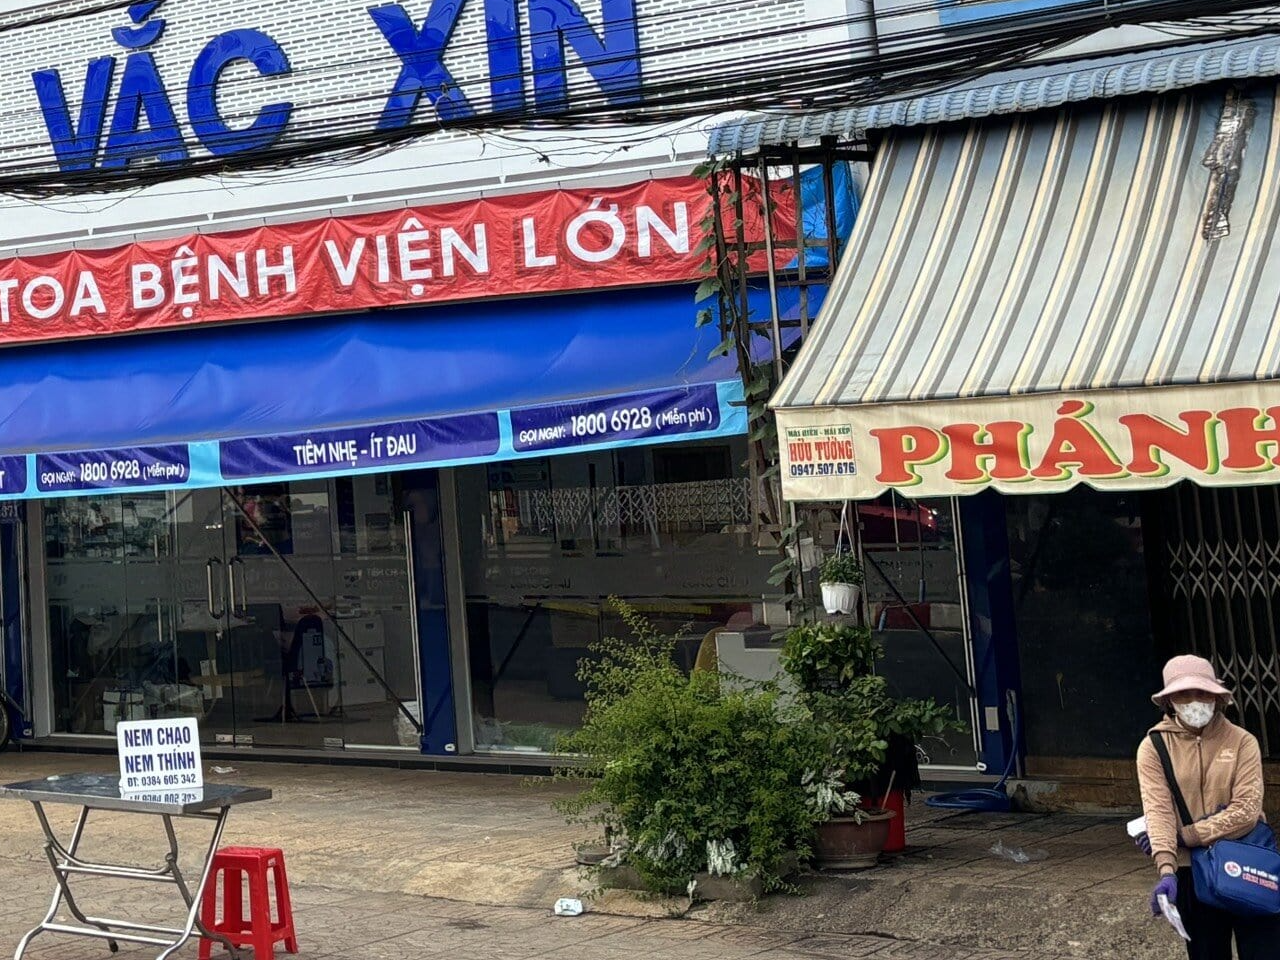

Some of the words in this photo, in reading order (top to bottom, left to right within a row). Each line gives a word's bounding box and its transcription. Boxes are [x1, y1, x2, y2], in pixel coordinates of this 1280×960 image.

[131, 245, 297, 319] BỆNH
[325, 218, 489, 297] VIỆN
[522, 196, 690, 269] LỚN
[519, 427, 538, 444] GỌI
[539, 425, 567, 442] NGAY:
[570, 411, 607, 437] 1800
[611, 406, 652, 433] 6928
[293, 439, 325, 467] TIÊM
[328, 440, 358, 469] NHẸ
[370, 434, 383, 459] ÍT
[386, 433, 417, 458] ĐAU
[41, 472, 56, 487] GỌI
[80, 462, 108, 482] 1800
[111, 460, 140, 480] 6928
[790, 461, 855, 476] 0947.507.676
[124, 728, 153, 748] NEM
[156, 726, 191, 748] CHẠO
[124, 754, 154, 773] NEM
[156, 748, 196, 771] THÍNH
[163, 775, 179, 786] 605
